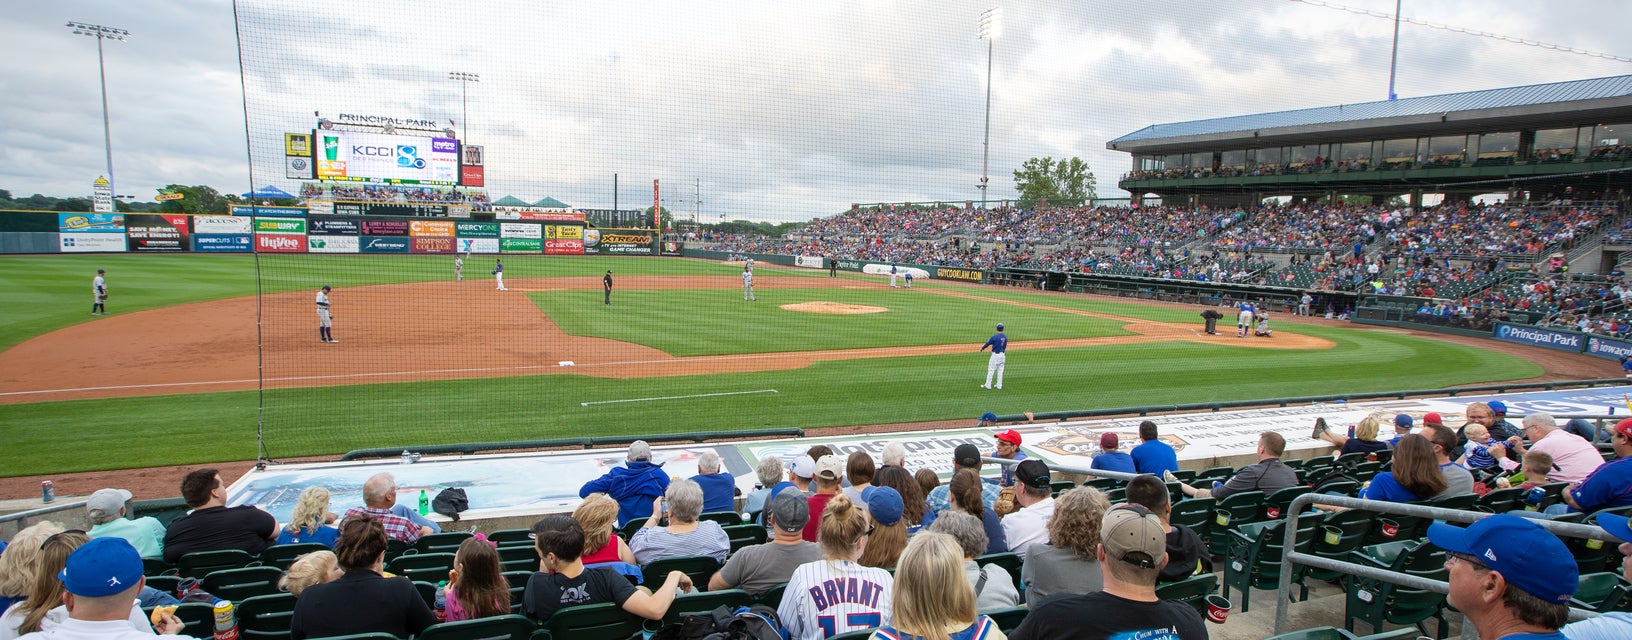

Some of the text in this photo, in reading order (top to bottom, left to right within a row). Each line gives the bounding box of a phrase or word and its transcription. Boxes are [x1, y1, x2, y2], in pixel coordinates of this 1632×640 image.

[339, 113, 436, 128] PRINCIPAL PARK
[352, 145, 393, 157] KCCI
[602, 235, 651, 243] XTREAM
[937, 268, 982, 280] GUYCOOKLAW.COM
[1510, 328, 1578, 347] Principal Park
[809, 577, 883, 612] BRYANT
[1172, 625, 1178, 634] A
